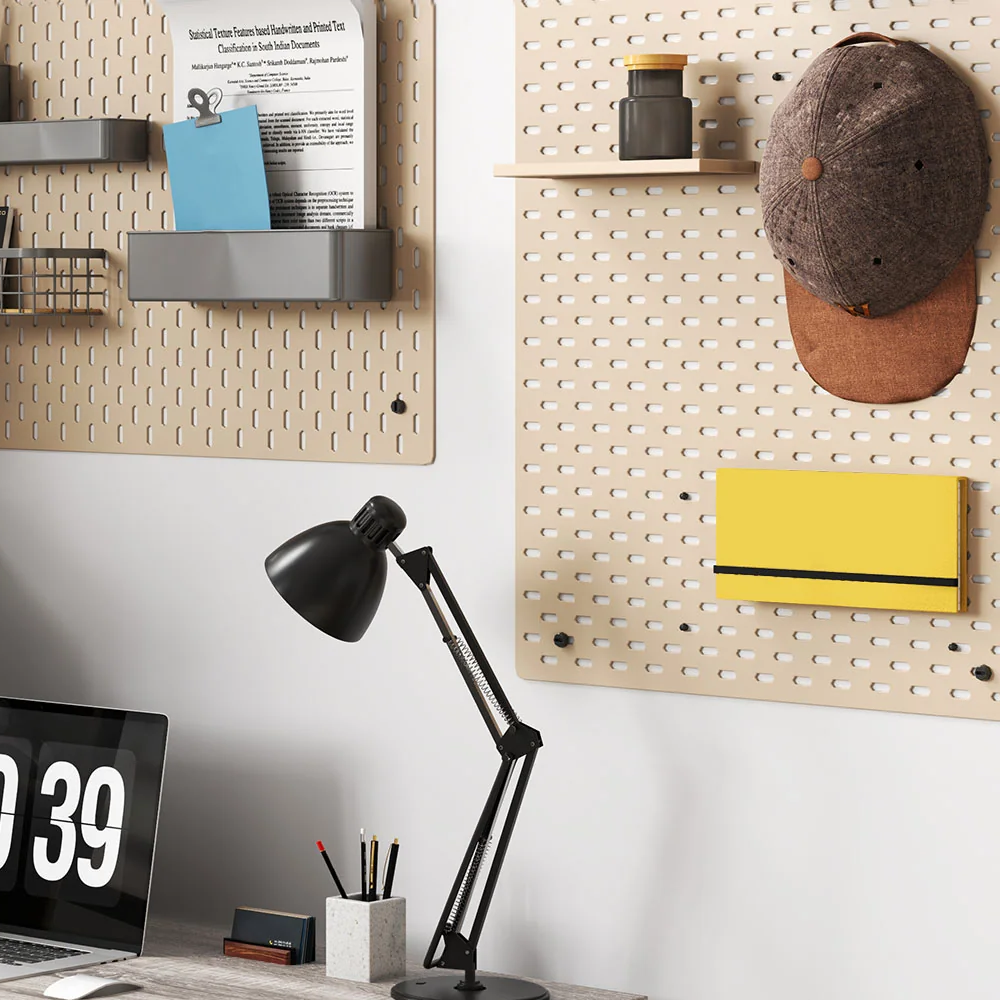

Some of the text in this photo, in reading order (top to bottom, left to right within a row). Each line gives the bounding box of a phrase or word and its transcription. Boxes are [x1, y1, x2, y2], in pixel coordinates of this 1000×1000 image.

[213, 28, 233, 38] Texture
[233, 27, 255, 37] Features
[255, 25, 270, 36] based
[270, 23, 302, 35] Handwritten
[303, 22, 312, 33] and
[313, 21, 332, 32] Printed
[332, 20, 345, 31] Text
[218, 40, 320, 53] Classification in South Indian Documents
[33, 761, 126, 888] 39
